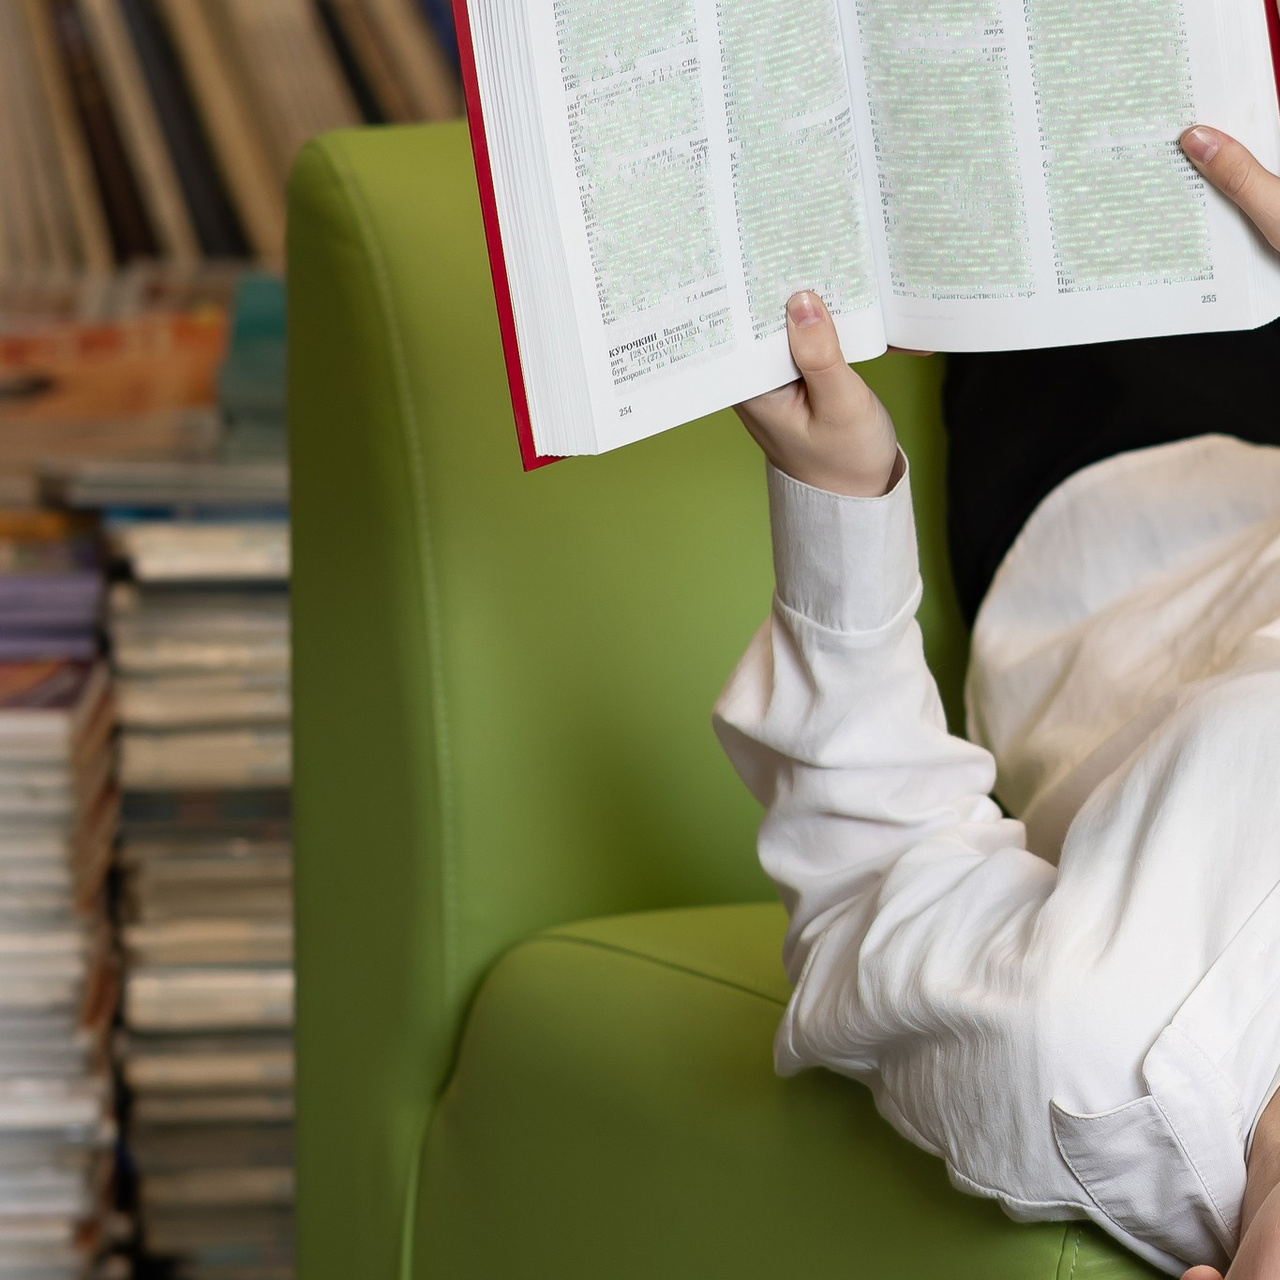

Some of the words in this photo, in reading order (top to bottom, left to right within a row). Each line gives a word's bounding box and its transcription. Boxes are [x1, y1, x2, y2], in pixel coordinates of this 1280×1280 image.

[1201, 294, 1217, 303] 255
[663, 320, 694, 337] Василий
[619, 405, 632, 417] 254
